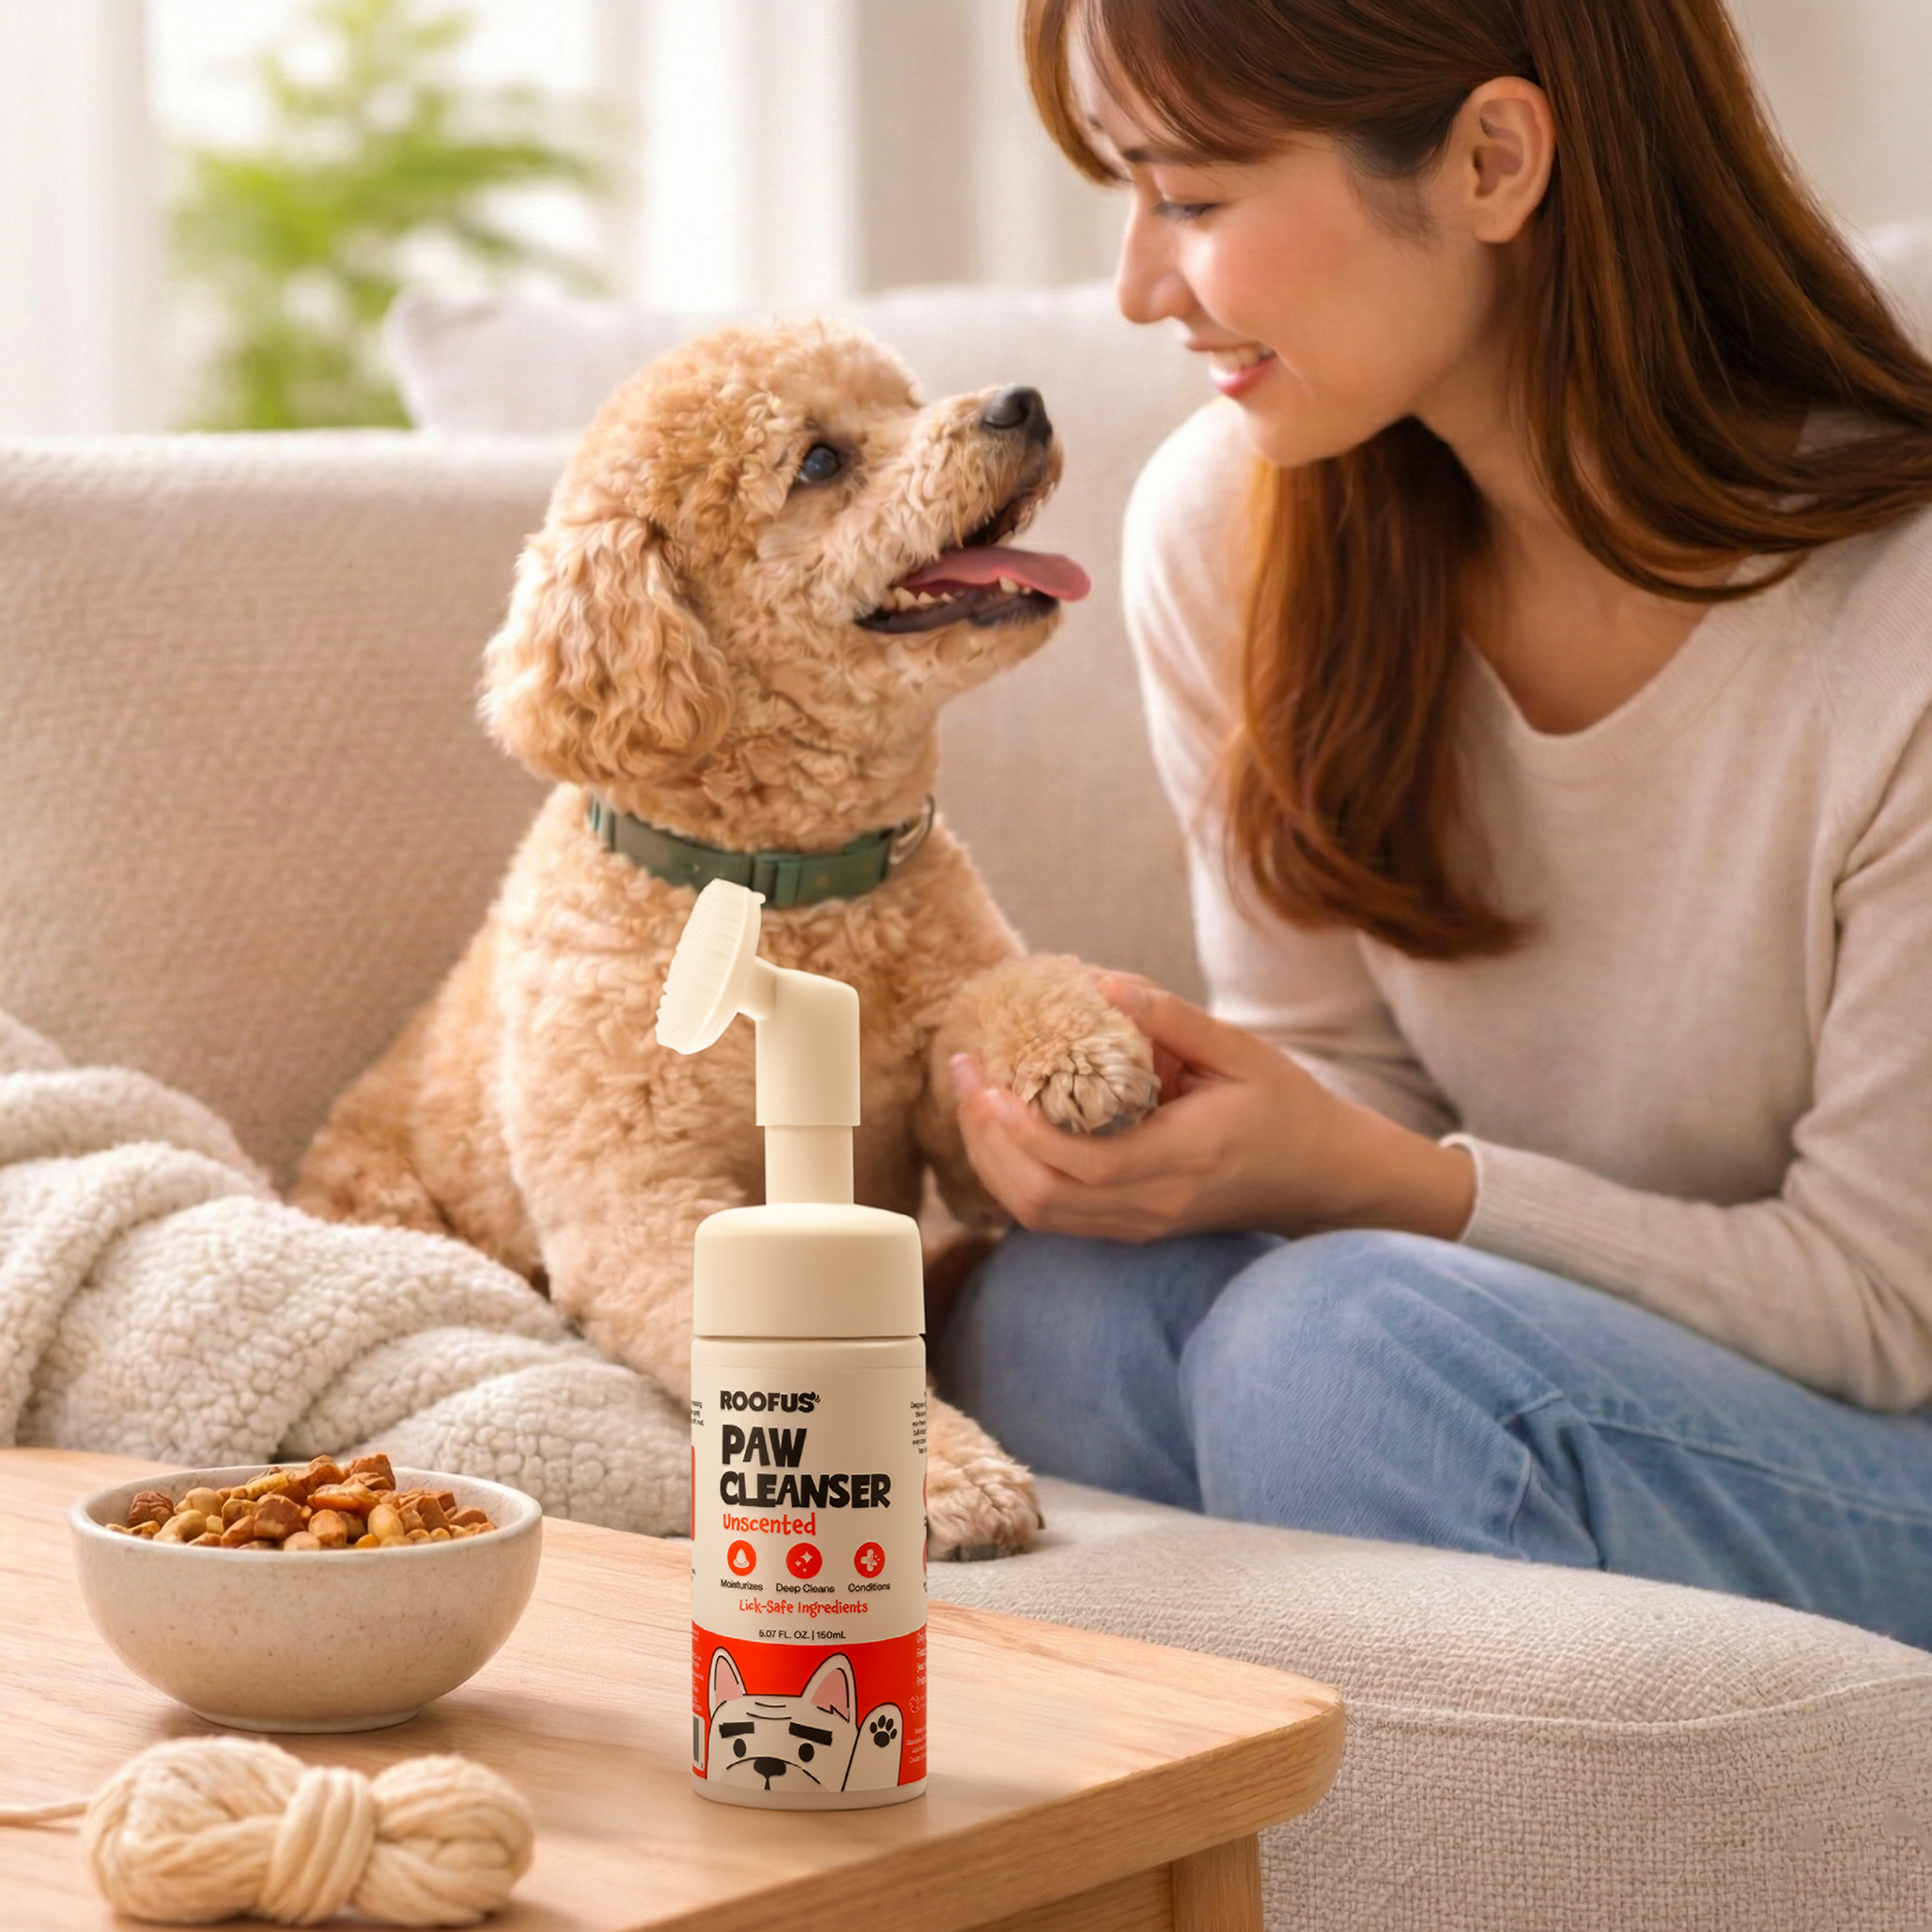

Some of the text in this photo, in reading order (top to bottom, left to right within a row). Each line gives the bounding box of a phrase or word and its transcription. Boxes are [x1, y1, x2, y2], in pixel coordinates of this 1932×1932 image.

[720, 1390, 817, 1412] ROOFUS
[722, 1424, 807, 1467] PAW
[720, 1470, 891, 1508] CLEANSER
[722, 1512, 816, 1535] Unscented
[720, 1579, 763, 1591] Moisturizes
[775, 1583, 835, 1594] Deep Cleans
[848, 1583, 891, 1593] Conditions
[739, 1597, 869, 1618] Lick-Safe Ingredients
[758, 1630, 776, 1638] 5.07
[778, 1630, 792, 1639] FL.
[793, 1631, 810, 1639] OZ.
[817, 1631, 847, 1639] 150mL
